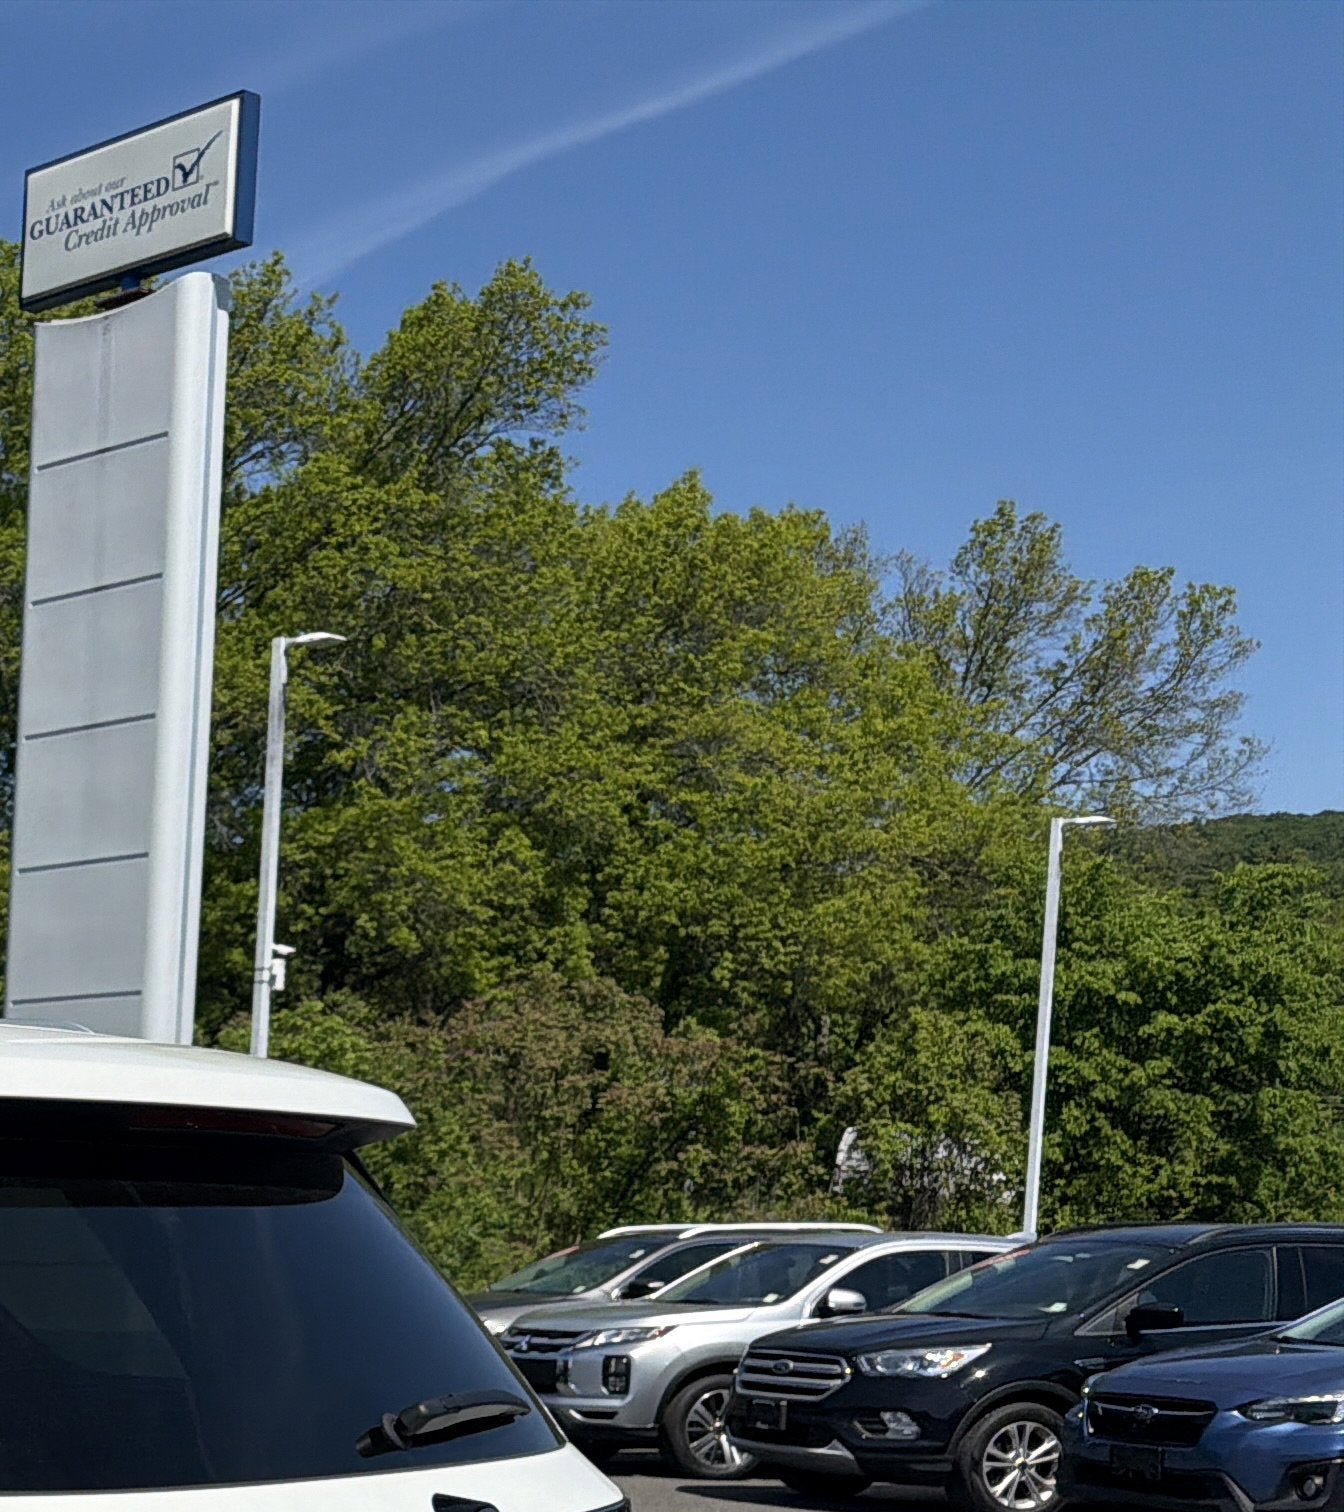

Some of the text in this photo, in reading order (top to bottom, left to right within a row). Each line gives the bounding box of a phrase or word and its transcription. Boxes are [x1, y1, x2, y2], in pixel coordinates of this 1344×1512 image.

[29, 176, 170, 241] GUARANTEED
[64, 182, 212, 252] Credit Approval
